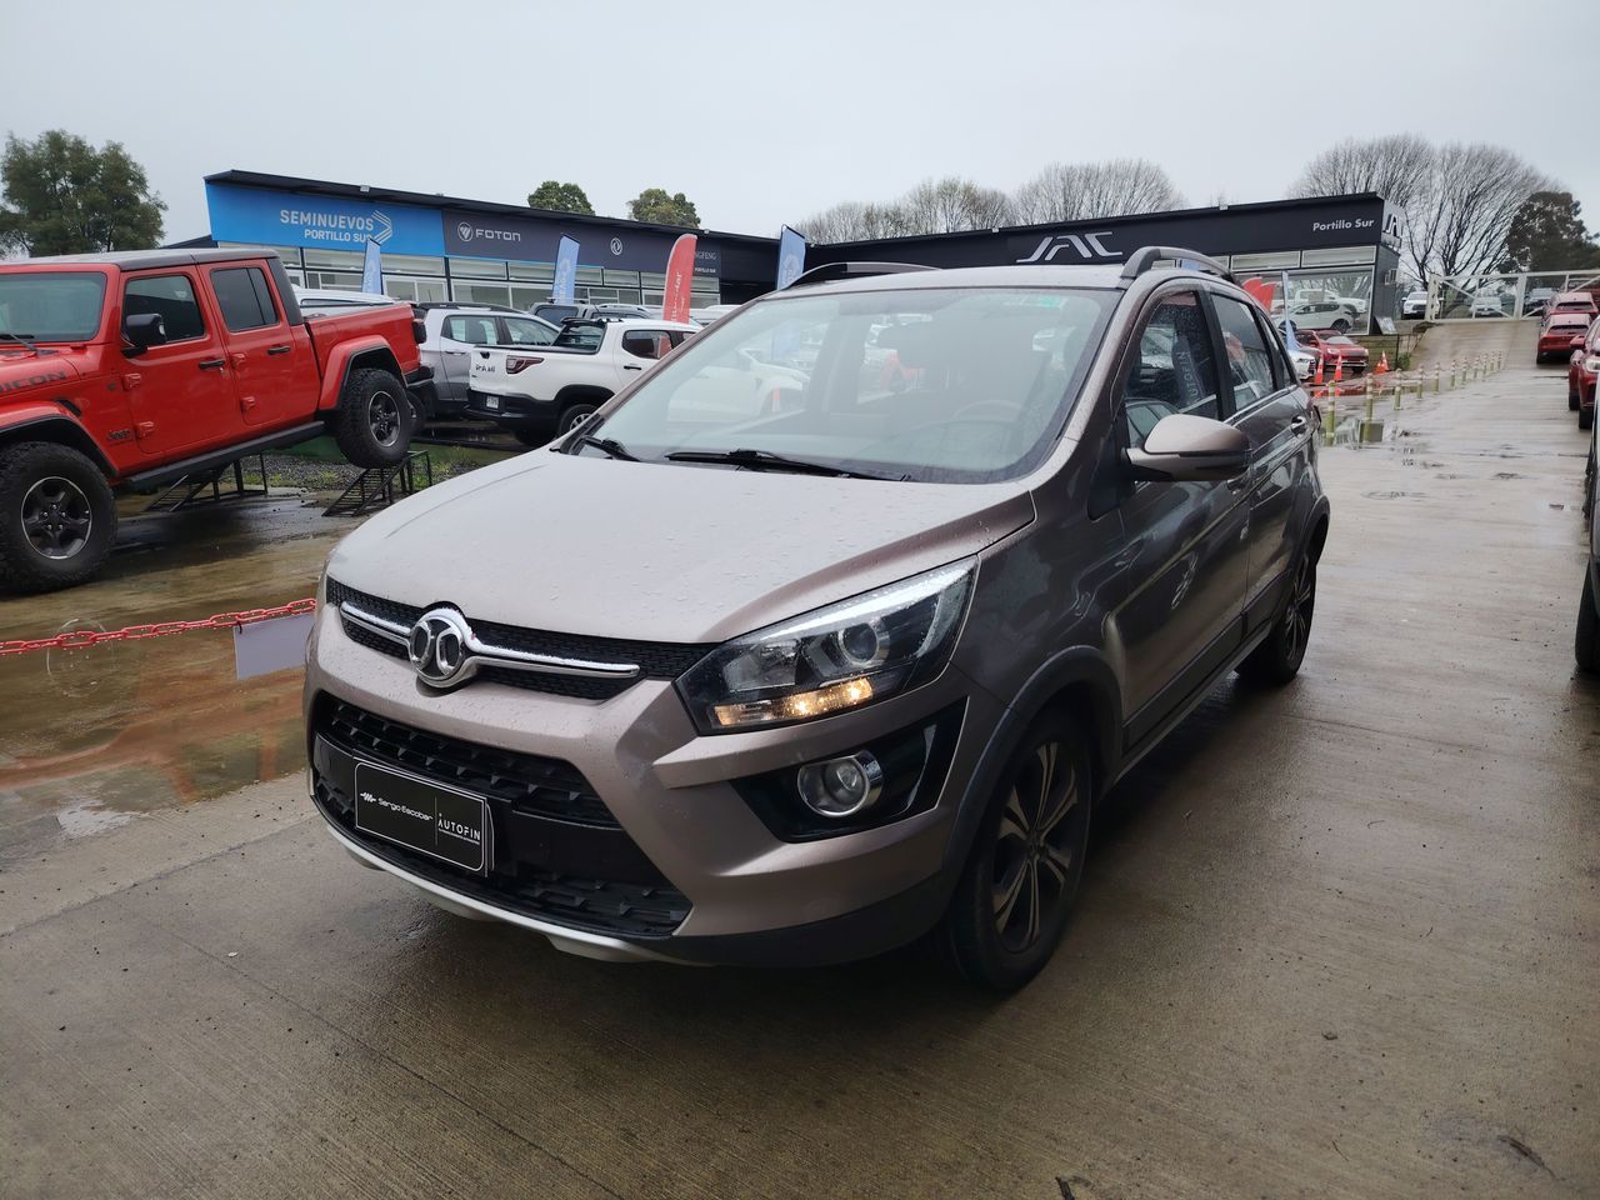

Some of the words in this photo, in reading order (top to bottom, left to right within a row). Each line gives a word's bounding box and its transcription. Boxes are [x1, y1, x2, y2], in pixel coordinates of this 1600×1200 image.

[280, 210, 374, 231] SEMINUEVOS
[1313, 221, 1352, 232] Portillo
[1354, 218, 1375, 228] Sur
[304, 228, 351, 242] PORTILLO
[475, 228, 521, 242] FOTON
[1016, 231, 1123, 263] JAC
[438, 814, 481, 841] AUTOFIN
